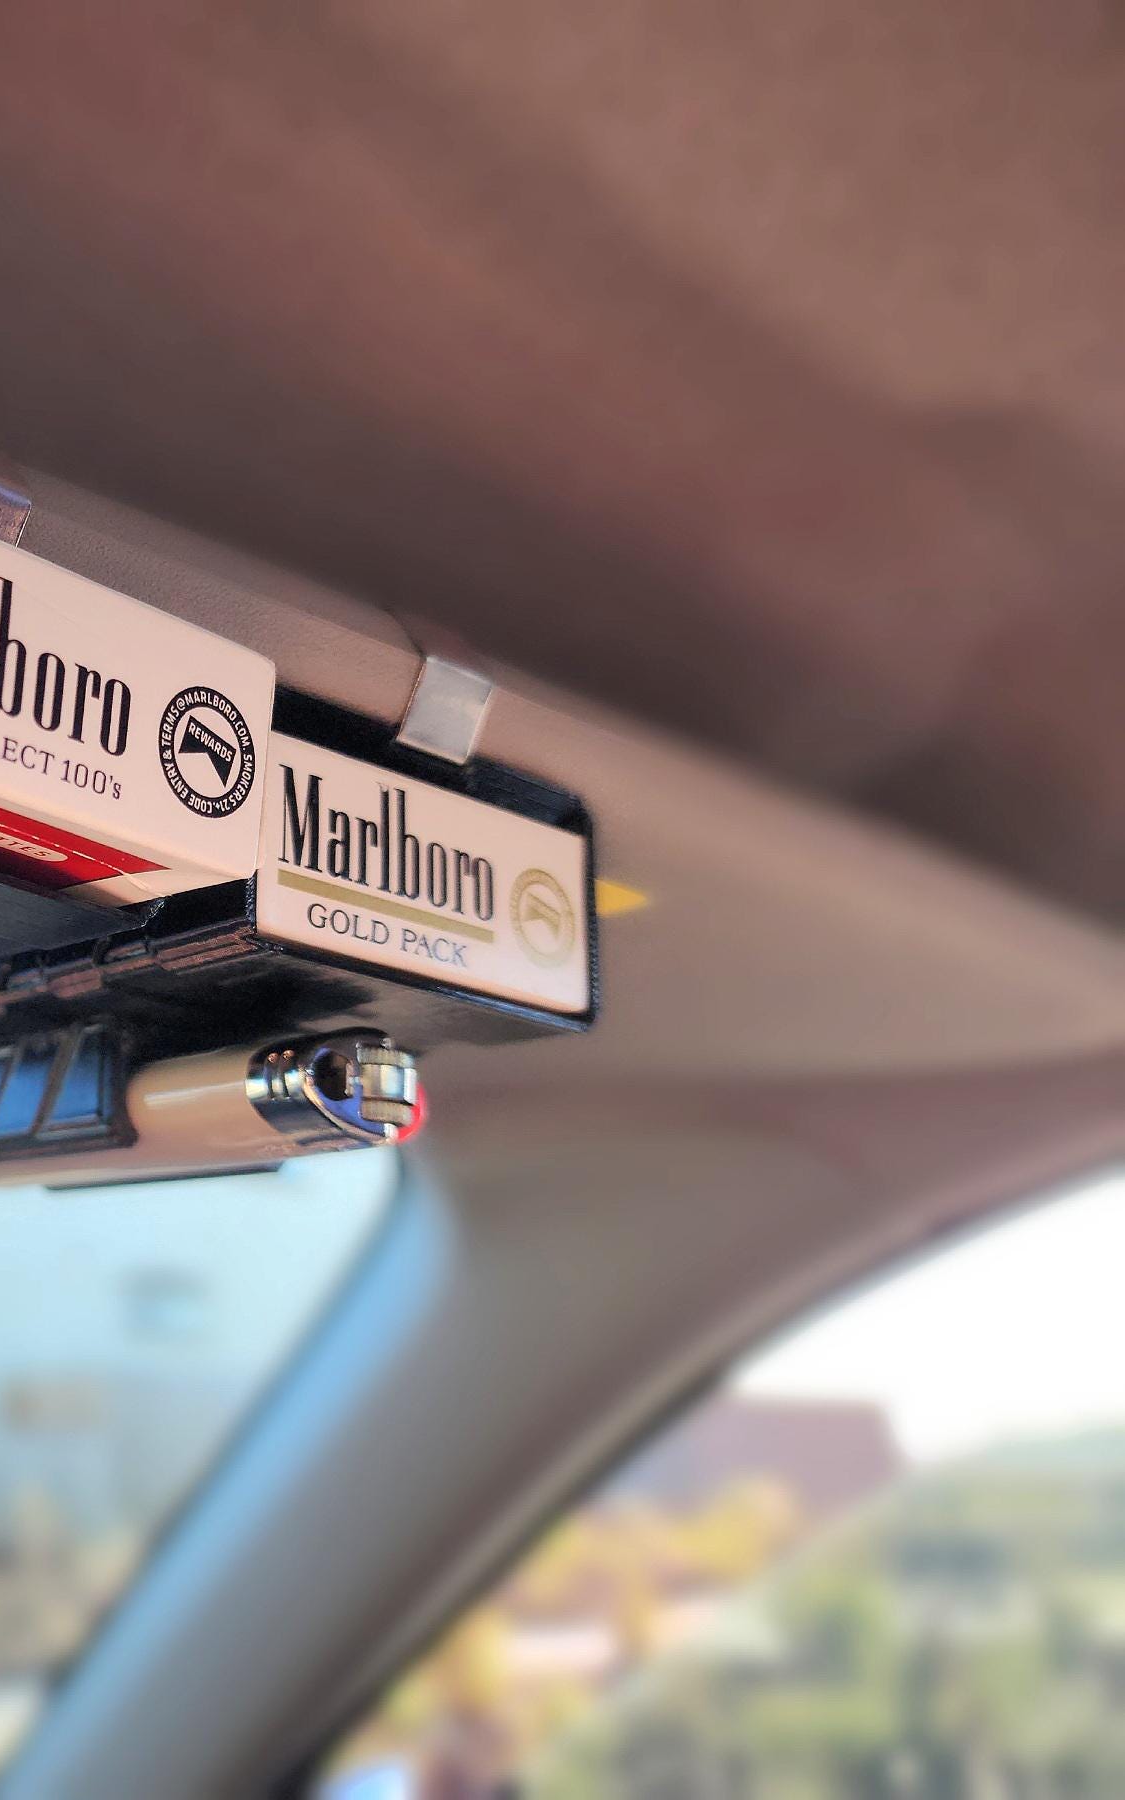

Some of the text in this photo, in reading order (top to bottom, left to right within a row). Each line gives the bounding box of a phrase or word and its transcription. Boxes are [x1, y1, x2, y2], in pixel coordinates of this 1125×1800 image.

[163, 750, 172, 760] &
[188, 722, 233, 763] REWARDS
[60, 759, 122, 800] 100's
[163, 762, 189, 799] ENTRY
[229, 753, 253, 807] SMOKERS
[188, 793, 213, 814] CODE
[278, 763, 494, 922] Marlboro
[307, 903, 468, 968] GOLD PACK
